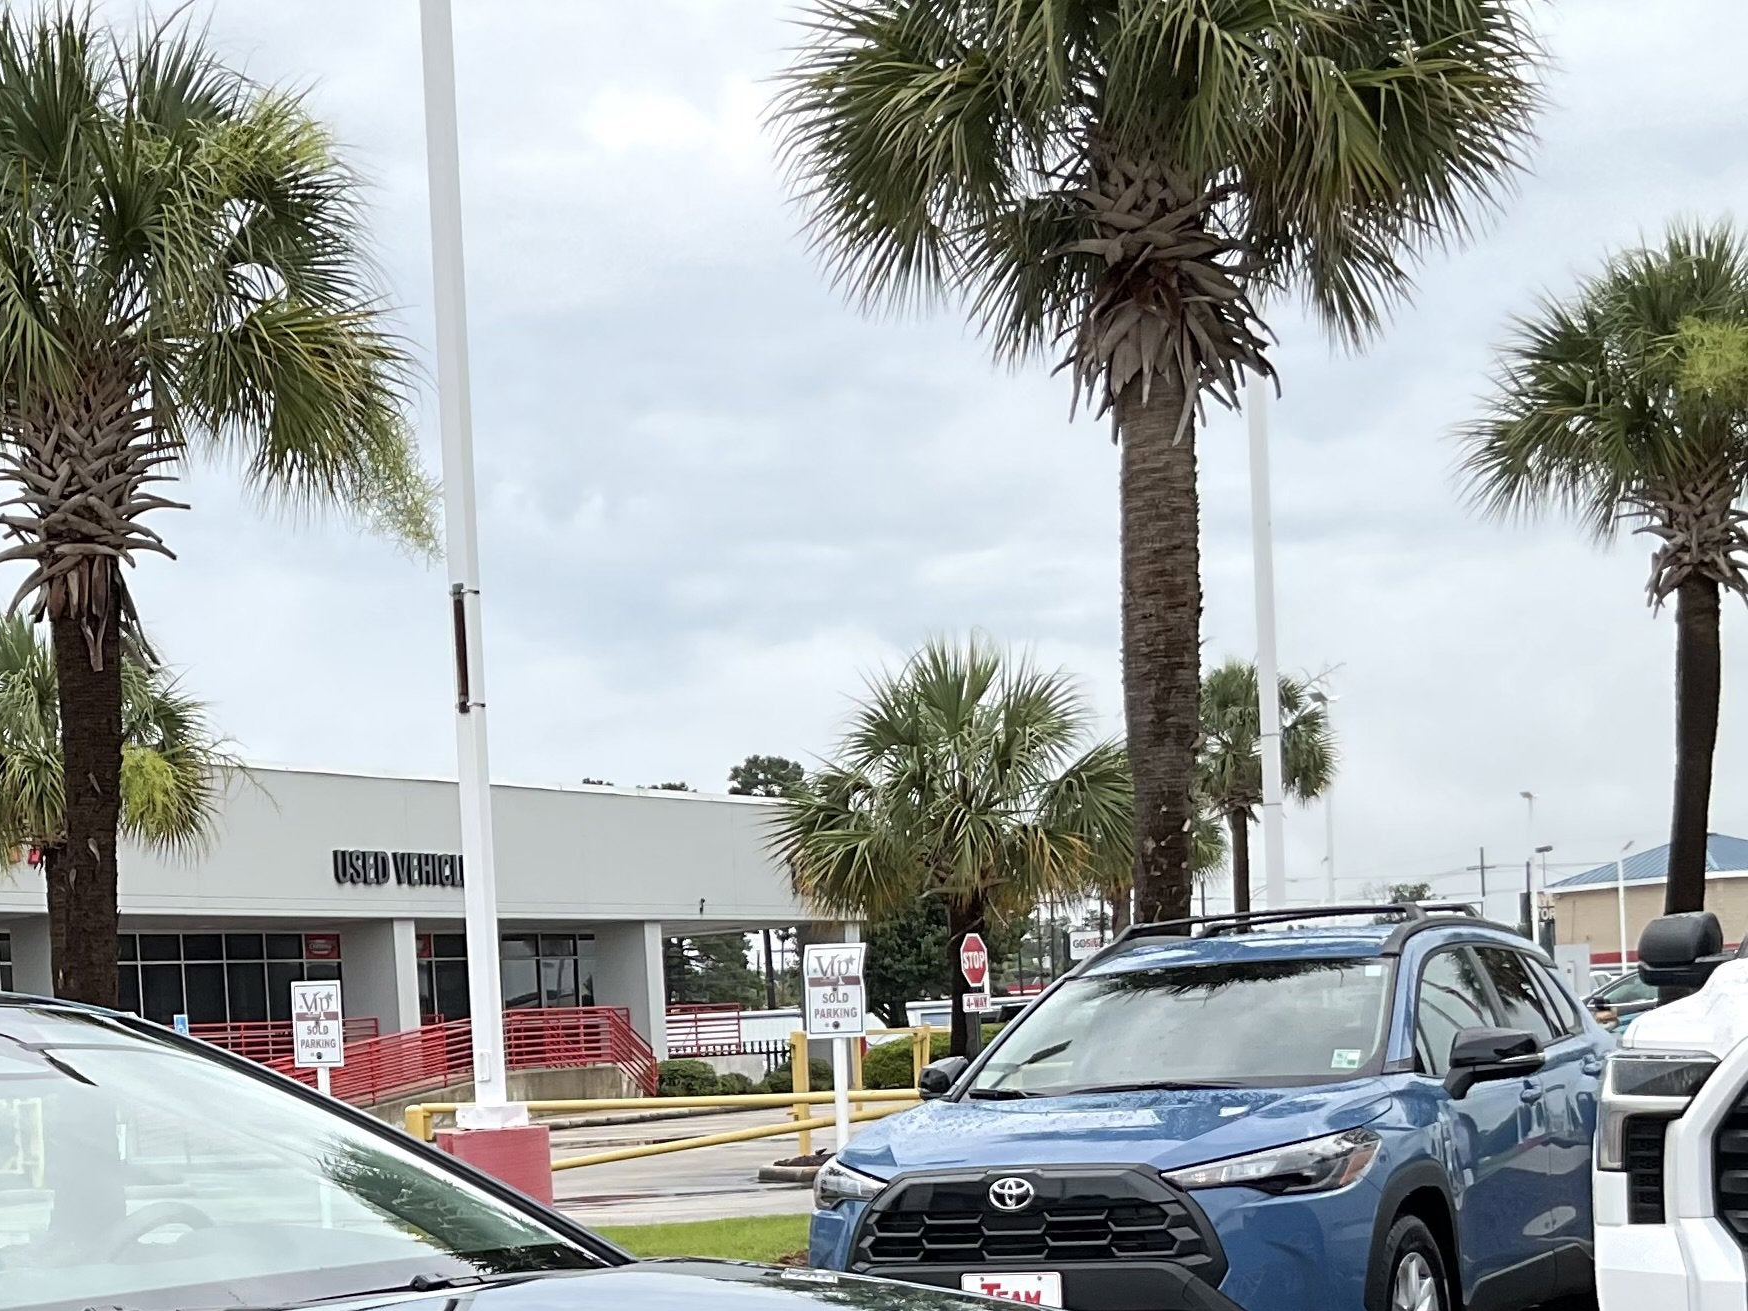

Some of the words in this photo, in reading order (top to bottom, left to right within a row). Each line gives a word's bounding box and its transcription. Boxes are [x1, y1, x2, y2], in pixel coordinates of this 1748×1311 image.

[333, 849, 390, 884] USED
[392, 851, 464, 887] VEHICL
[963, 951, 985, 969] STOP
[822, 992, 849, 1004] SOLD
[966, 997, 988, 1008] 4-WAY
[814, 1006, 858, 1019] PARKING
[306, 1025, 329, 1035] SOLD
[300, 1038, 337, 1049] PARKING
